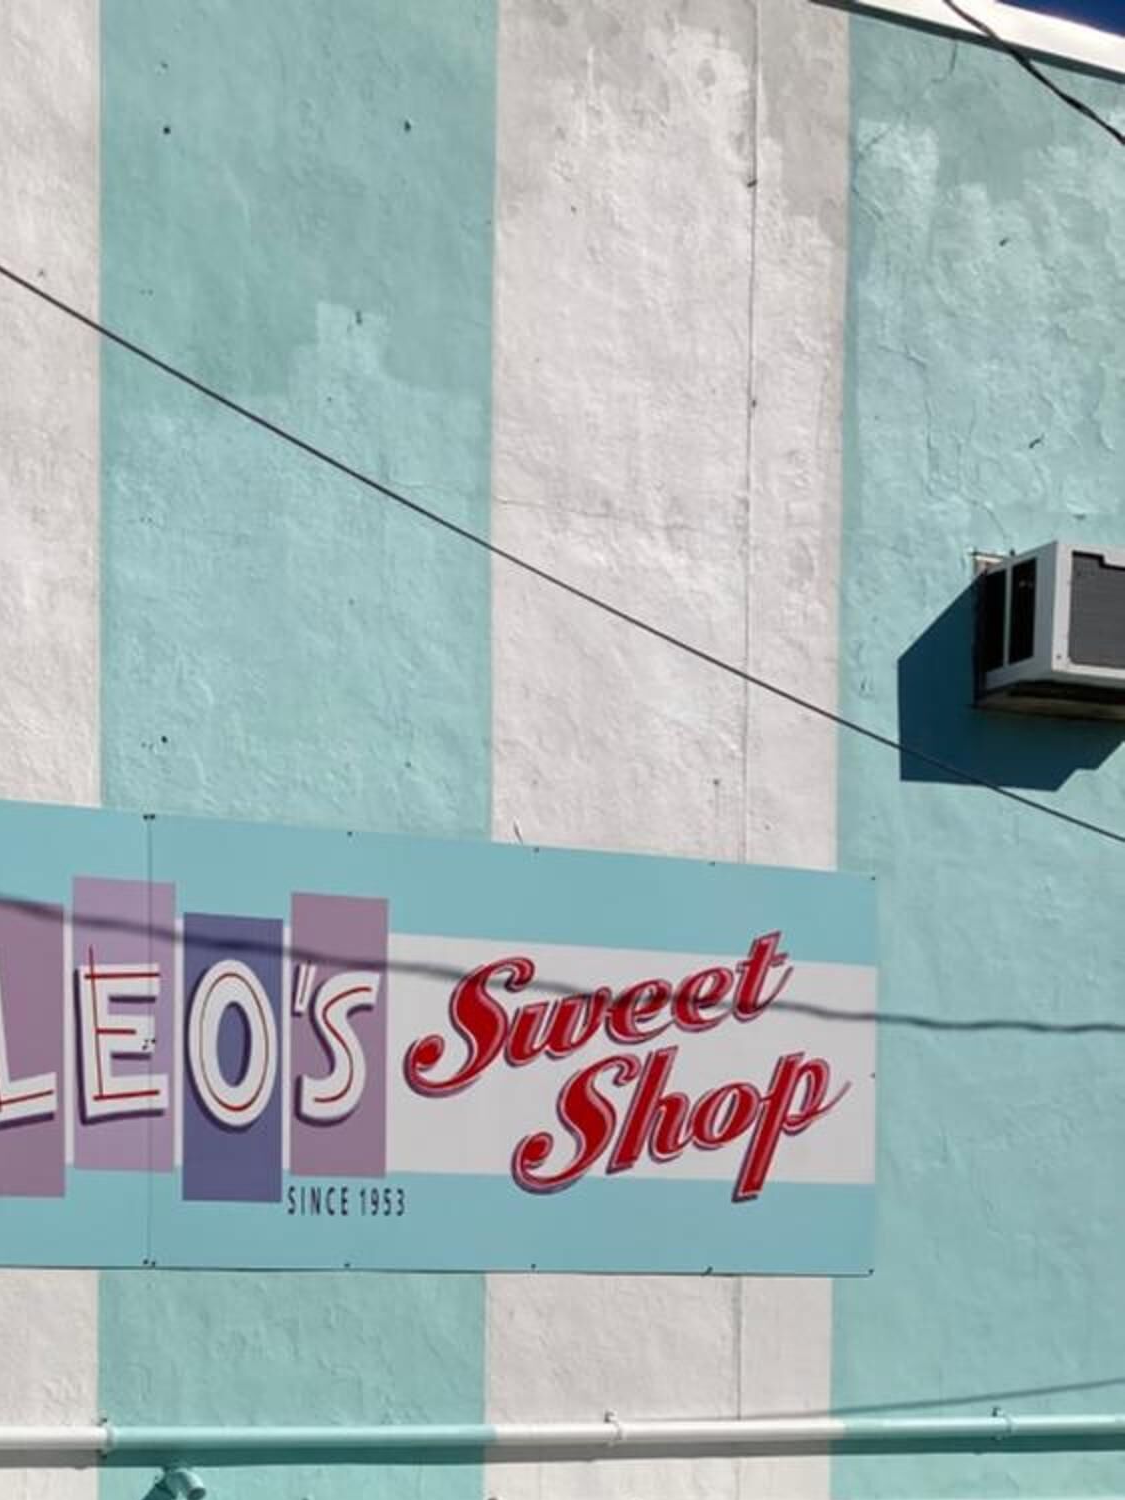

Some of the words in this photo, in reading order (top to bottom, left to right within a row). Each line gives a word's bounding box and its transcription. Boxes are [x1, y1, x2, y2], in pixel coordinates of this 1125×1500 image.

[402, 931, 795, 1098] Sweet
[287, 1186, 350, 1216] SINCE
[359, 1187, 406, 1216] 1953
[511, 1046, 852, 1204] Shop
